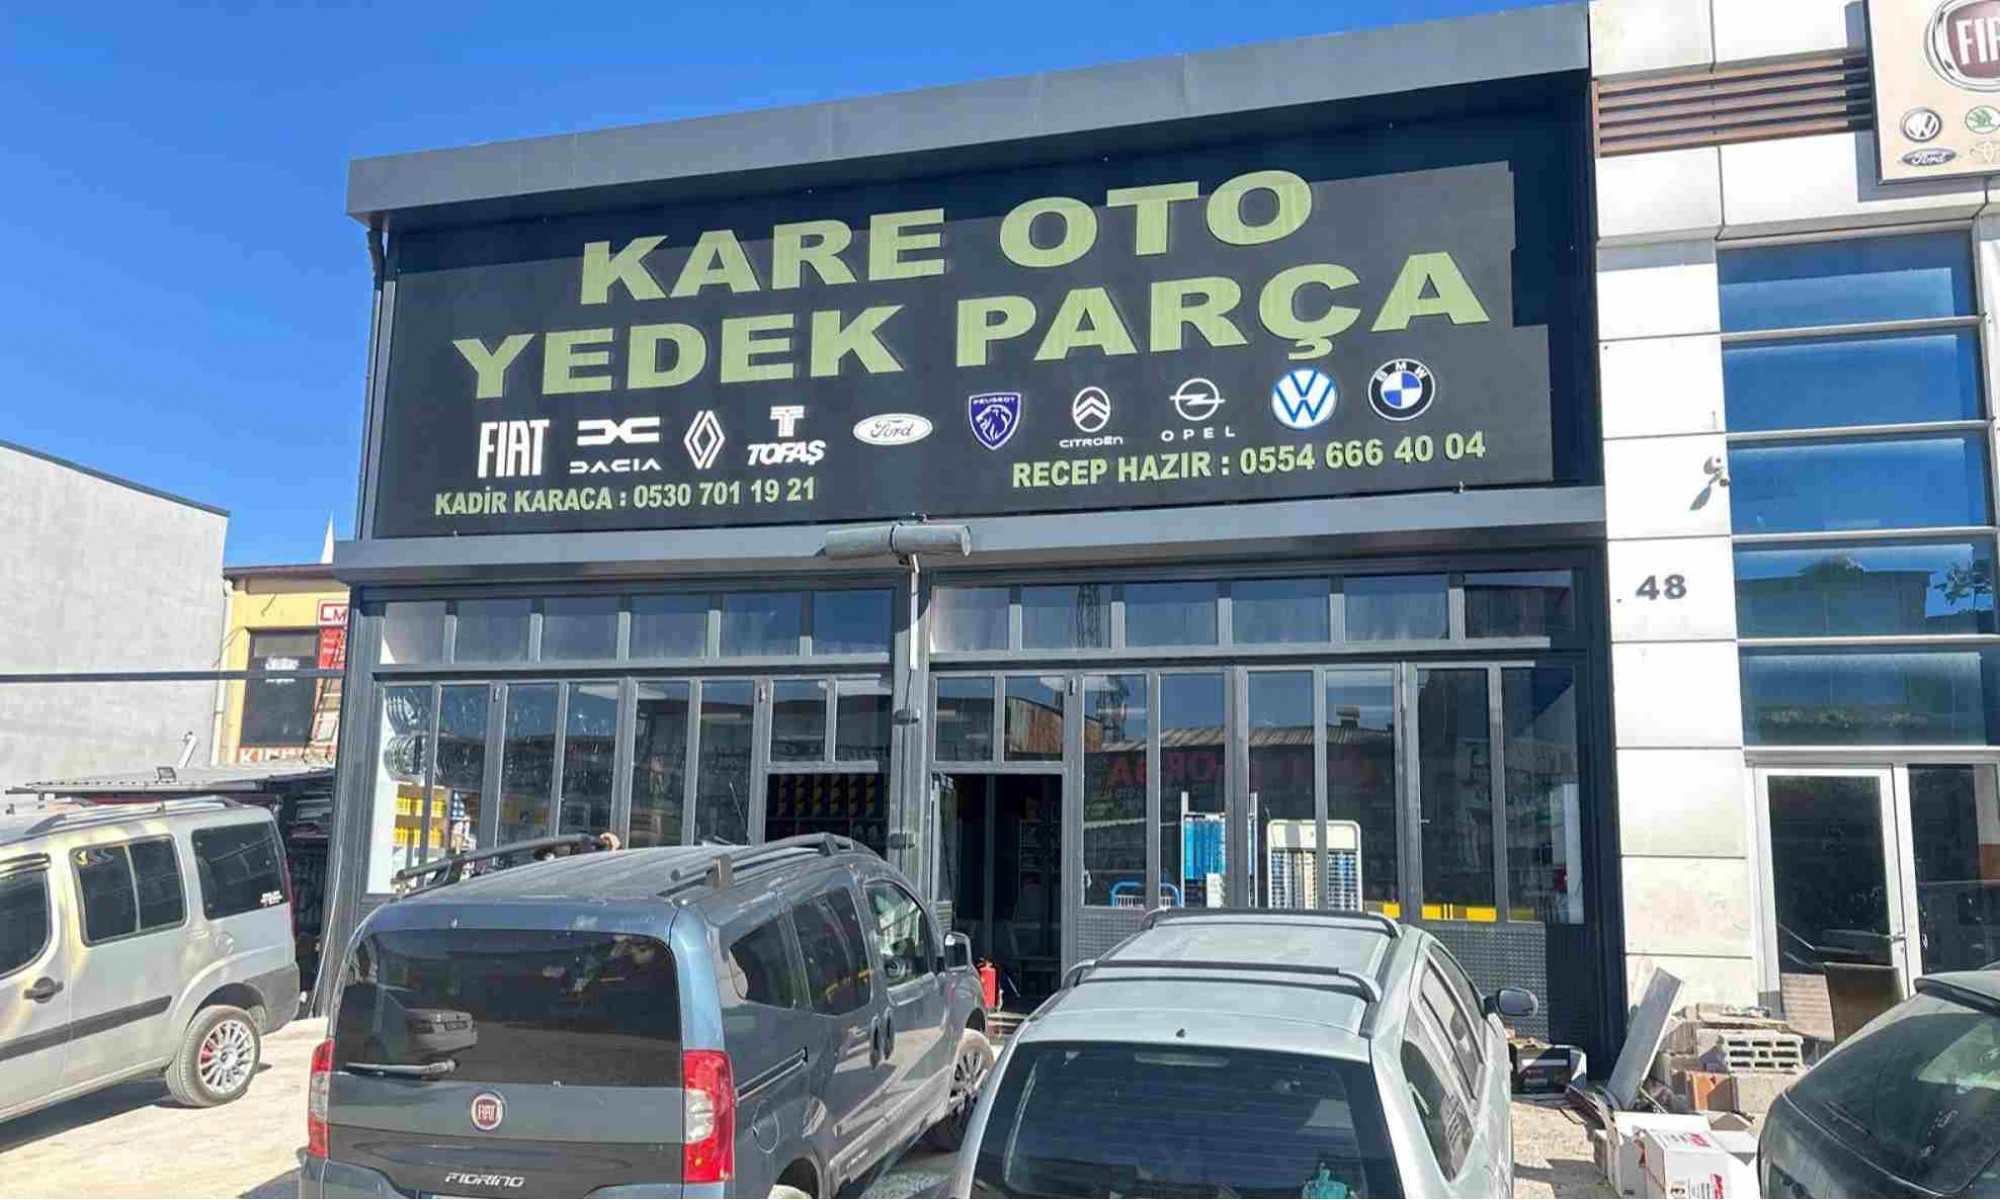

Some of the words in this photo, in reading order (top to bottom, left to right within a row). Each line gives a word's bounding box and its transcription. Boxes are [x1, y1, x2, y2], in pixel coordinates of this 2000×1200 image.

[1956, 17, 2000, 65] FIA
[580, 208, 946, 304] KARE
[999, 169, 1313, 268] OTO
[452, 305, 905, 400] YEDEK
[955, 251, 1491, 368] PARÇA
[1375, 360, 1428, 383] BMW
[870, 418, 915, 438] Ford
[1160, 426, 1236, 443] OPEL
[477, 418, 550, 478] FIAT
[747, 439, 827, 467] TOFAŞ
[1012, 457, 1108, 489] RECEP
[1117, 451, 1212, 483] HAZIR
[1239, 443, 1316, 475] 0554
[1326, 438, 1384, 470] 666
[1394, 434, 1434, 464] 40
[1445, 430, 1487, 460] 04
[569, 458, 662, 475] DACIA
[435, 486, 507, 516] KADİR
[513, 487, 613, 514] KARACA
[633, 483, 692, 509] 0530
[699, 480, 741, 506] 701
[751, 479, 781, 504] 19
[786, 476, 815, 502] 21
[1635, 574, 1687, 601] 48
[444, 1172, 525, 1188] FIORINO
